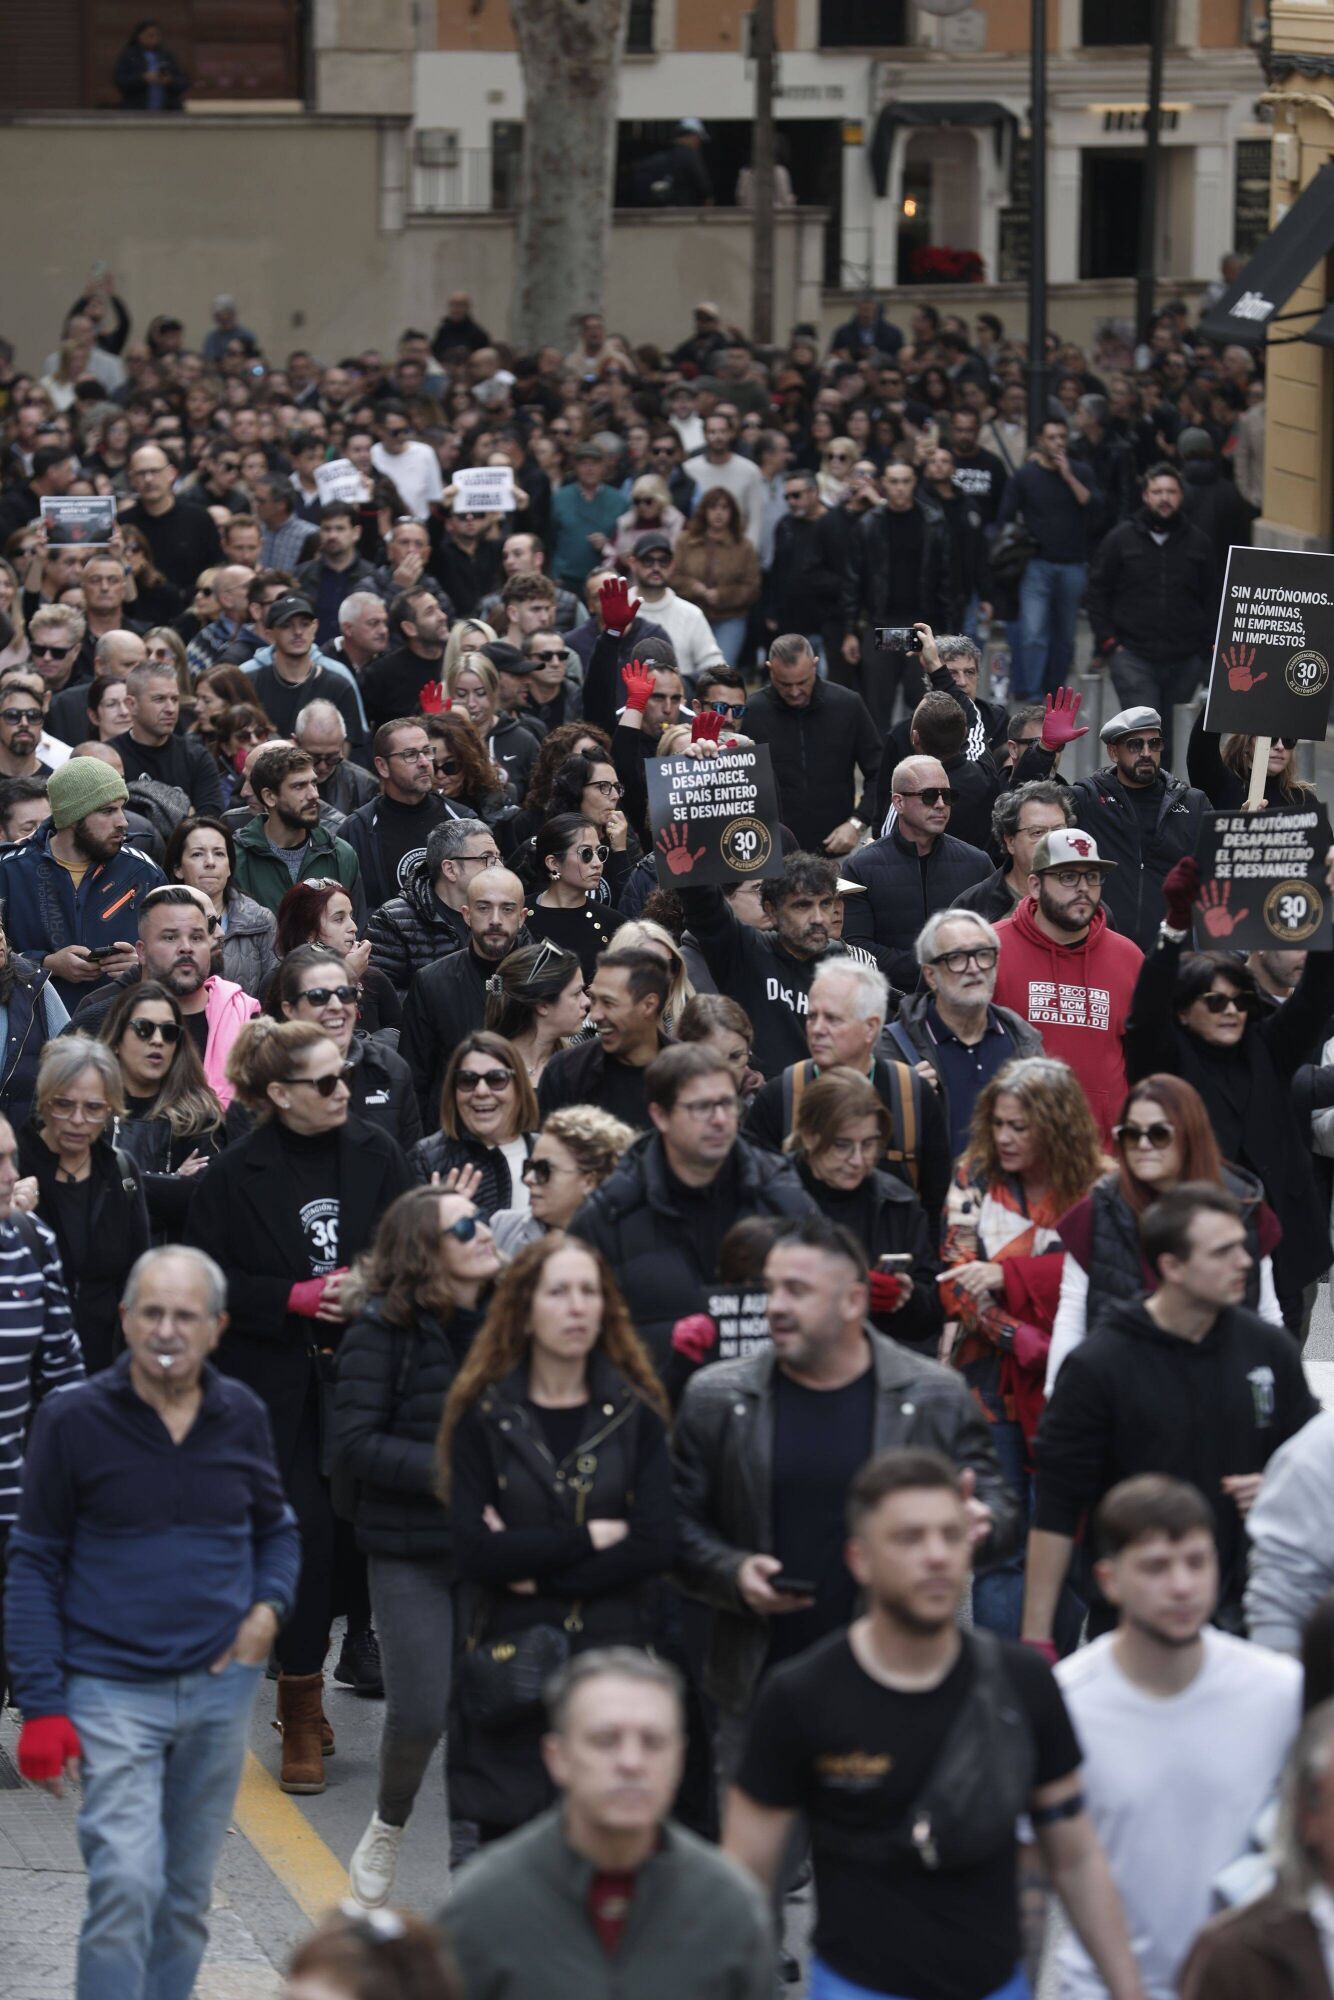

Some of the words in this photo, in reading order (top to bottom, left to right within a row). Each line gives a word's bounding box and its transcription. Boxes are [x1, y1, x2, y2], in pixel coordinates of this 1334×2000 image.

[1231, 585, 1251, 599] SIN
[1235, 602, 1248, 614] NI
[1249, 602, 1303, 621] NÓMINAS,
[1233, 617, 1246, 629] NI
[1247, 618, 1306, 635] EMPRESAS,
[1231, 631, 1244, 643] NI
[1245, 632, 1306, 648] IMPUESTOS
[1297, 662, 1317, 679] 30
[1302, 678, 1309, 686] N
[660, 763, 673, 776] SI
[675, 761, 690, 774] EL
[672, 770, 748, 789] DESAPARECE,
[669, 792, 684, 806] EL
[685, 788, 712, 804] PAÍS
[714, 785, 758, 802] ENTERO
[672, 807, 688, 821] SE
[690, 800, 756, 820] DESVANECE
[1214, 818, 1230, 833] SI
[1230, 818, 1247, 832] EL
[1248, 812, 1319, 832] AUTÓNOMO
[734, 830, 757, 852] 30
[1222, 830, 1309, 848] DESAPARECE,
[742, 850, 751, 861] N
[1214, 848, 1231, 863] EL
[1232, 845, 1264, 862] PAÍS
[1264, 846, 1315, 862] ENTERO
[1214, 862, 1233, 879] SE
[1233, 861, 1309, 879] DESVANECE
[1280, 895, 1307, 919] 30
[1031, 996, 1051, 1006] EST
[323, 1244, 338, 1261] N
[708, 1294, 740, 1317] SIN
[720, 1319, 738, 1338] NI
[720, 1340, 738, 1358] NI
